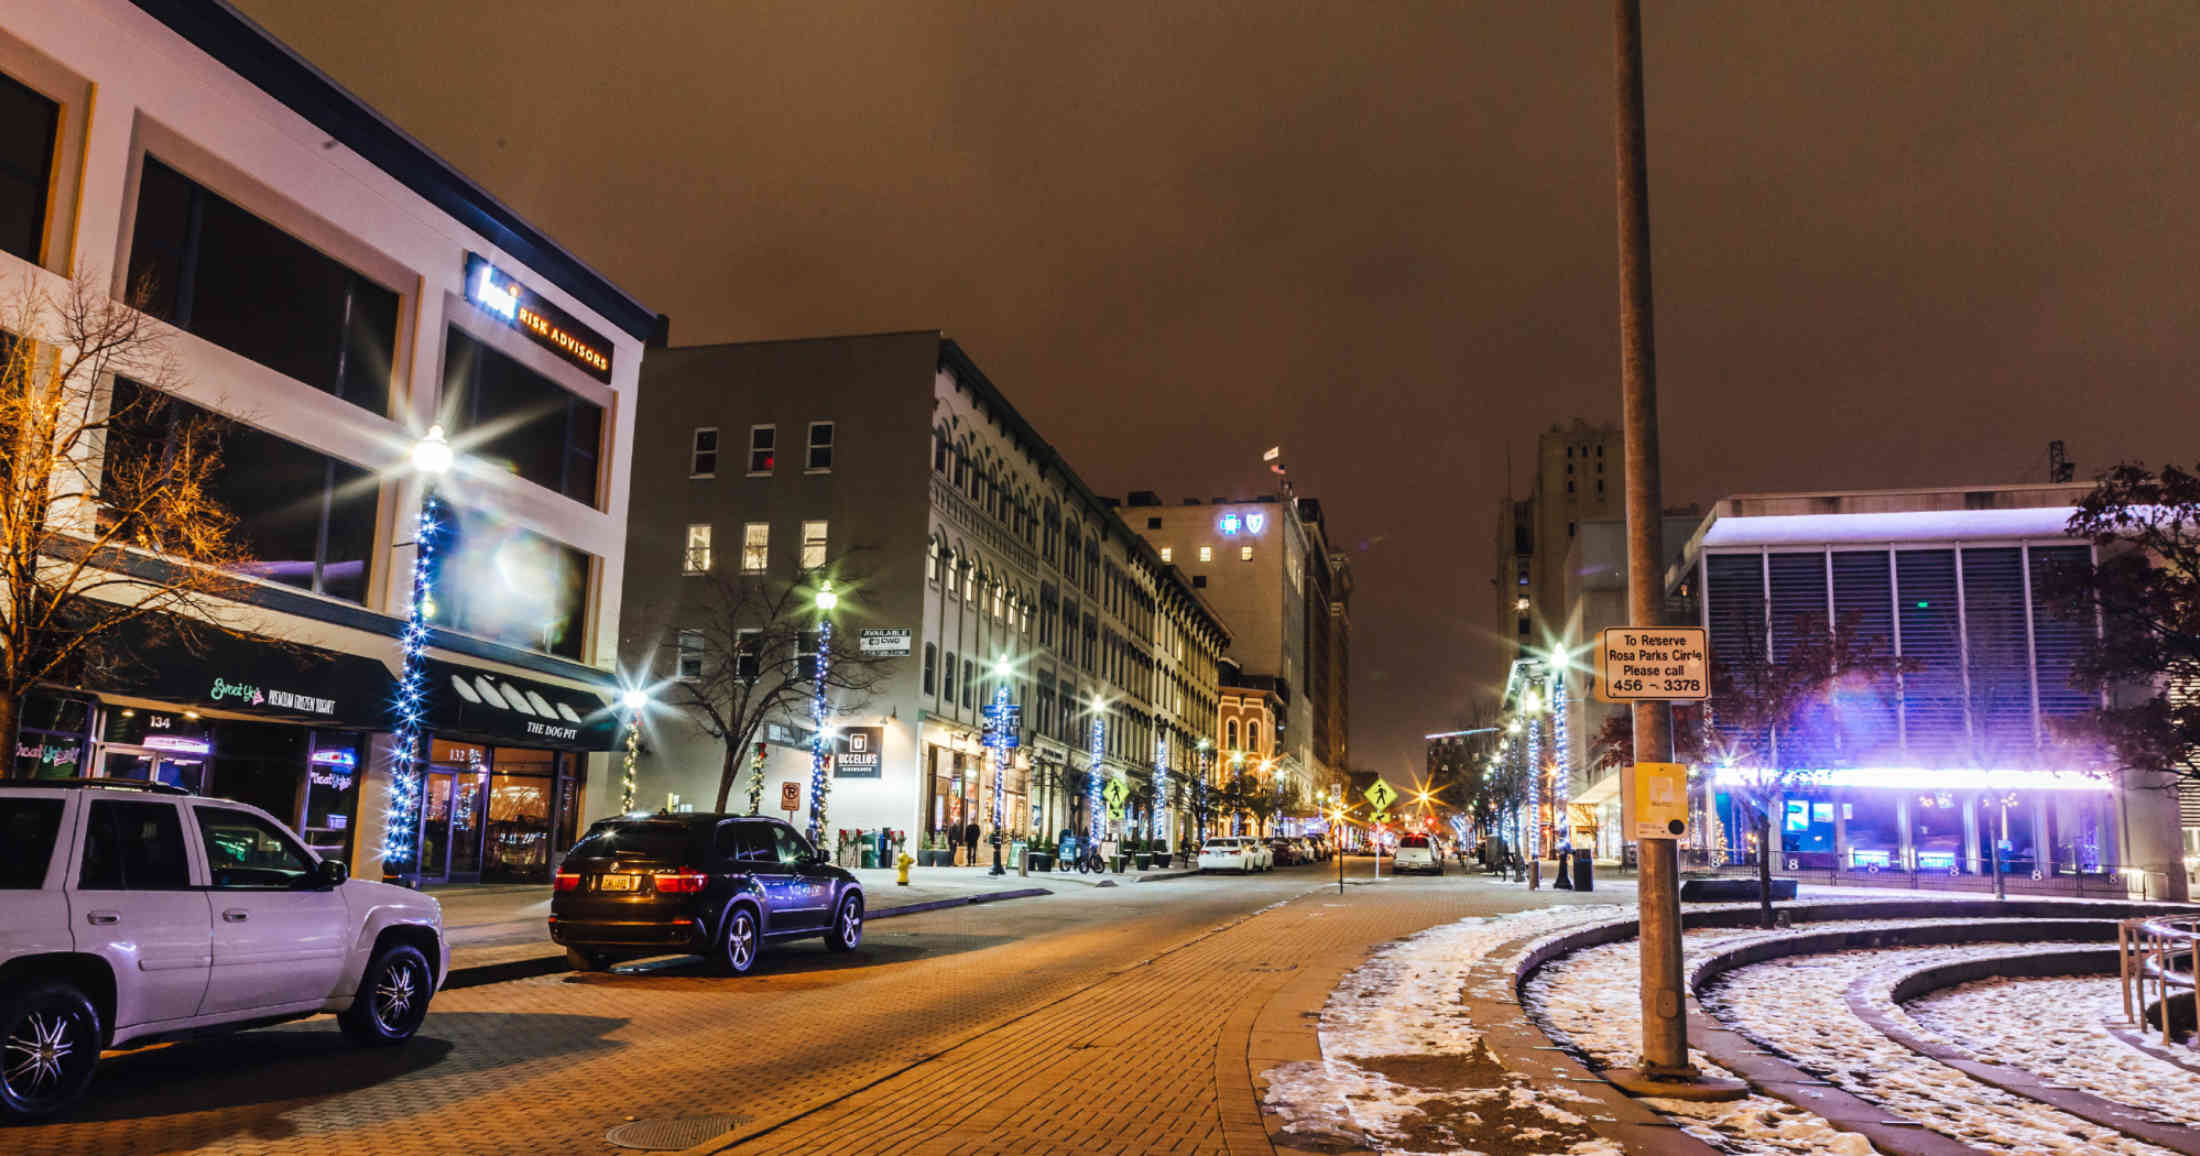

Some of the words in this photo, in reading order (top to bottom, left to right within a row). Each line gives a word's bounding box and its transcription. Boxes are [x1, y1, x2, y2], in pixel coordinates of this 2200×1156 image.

[519, 307, 548, 335] RISK
[551, 328, 608, 371] ADVISORS
[1624, 634, 1637, 646] To
[1641, 634, 1686, 646] Reserve
[1609, 649, 1635, 661] Rosa
[1639, 649, 1668, 661] Parks
[1623, 665, 1660, 676] Please
[1664, 665, 1684, 676] call
[1614, 680, 1643, 691] 456
[1664, 680, 1700, 691] 3378
[151, 716, 171, 729] 134
[527, 721, 544, 735] THE
[545, 725, 563, 738] DOG
[563, 728, 577, 740] PIT
[449, 748, 465, 762] 132
